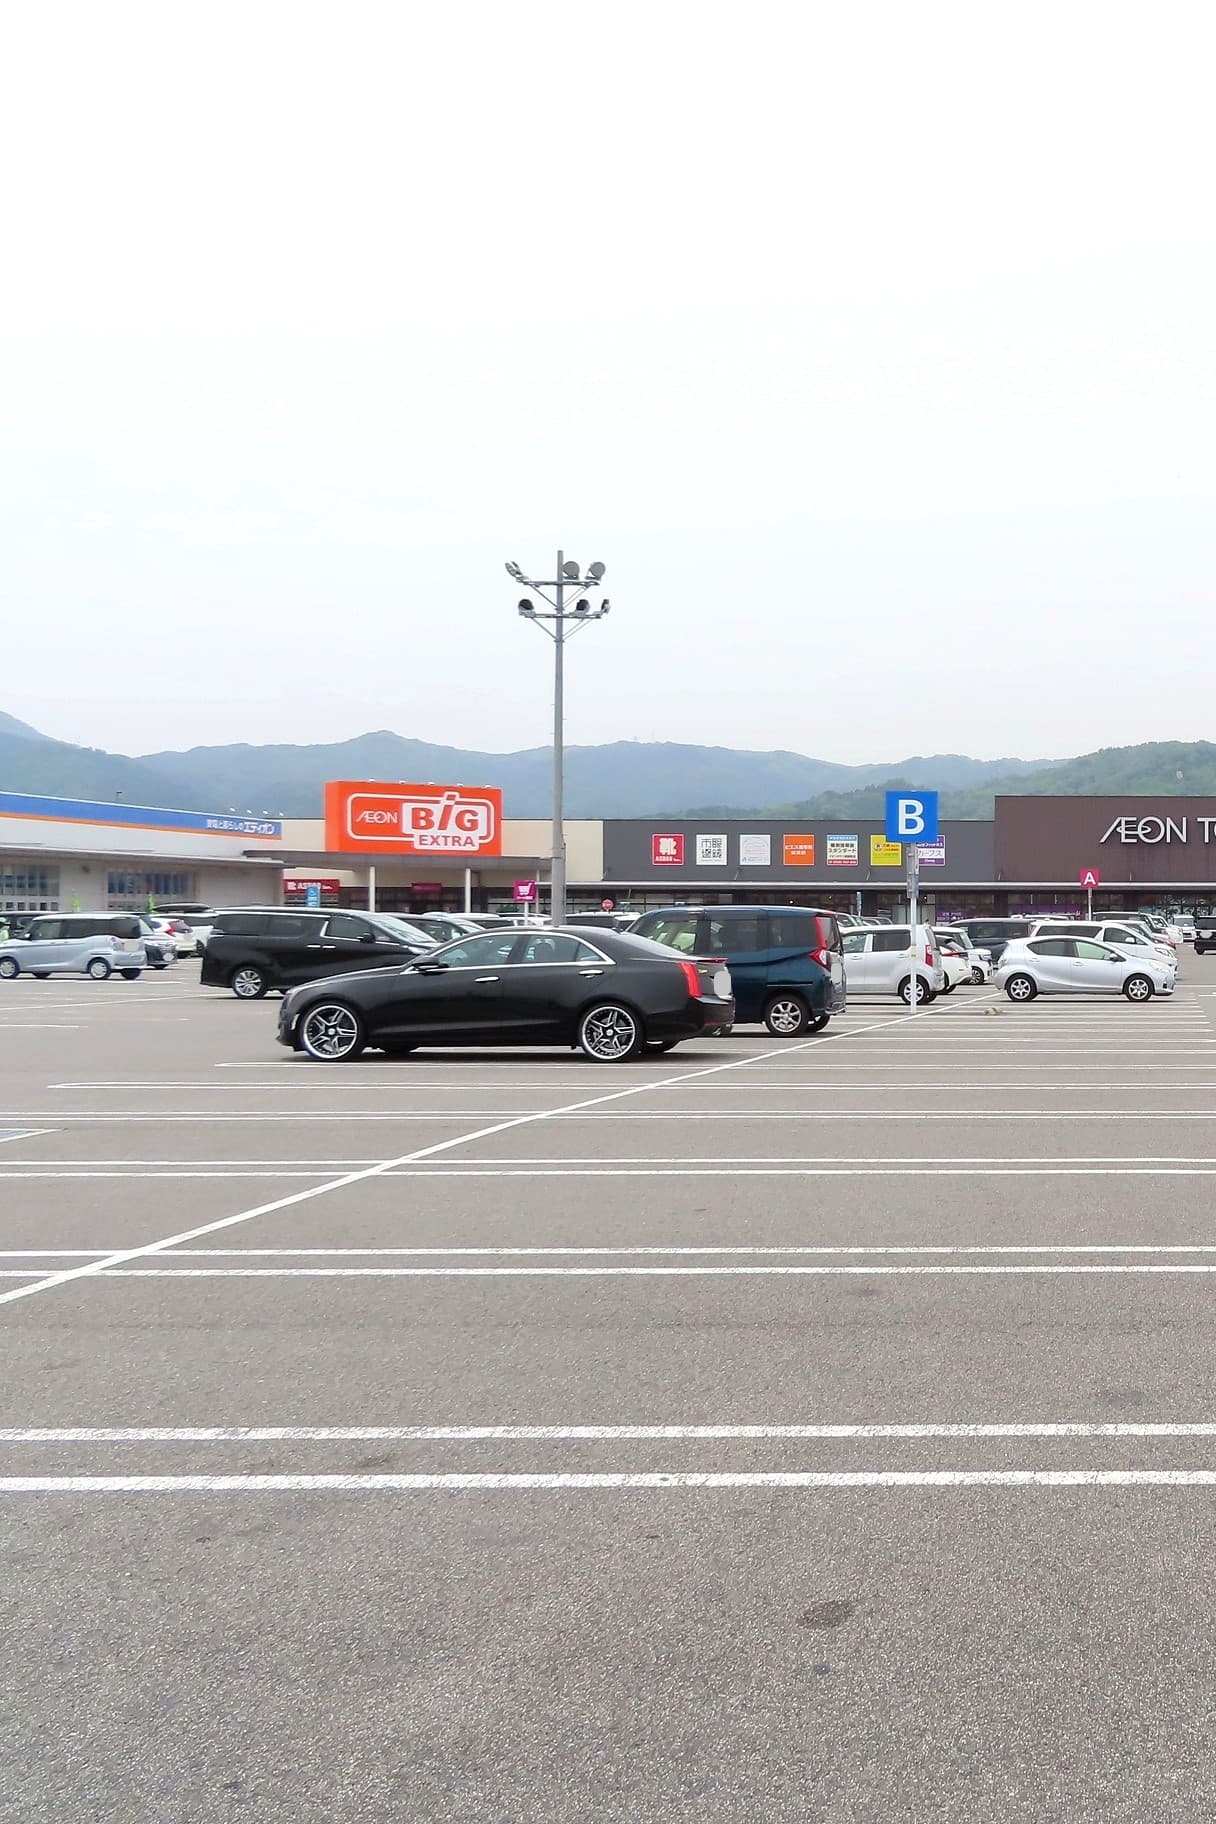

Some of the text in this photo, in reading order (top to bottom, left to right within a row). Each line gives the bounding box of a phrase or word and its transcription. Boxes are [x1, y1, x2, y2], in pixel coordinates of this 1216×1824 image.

[898, 799, 926, 835] B
[418, 834, 476, 848] EXTRA
[1083, 871, 1096, 886] A
